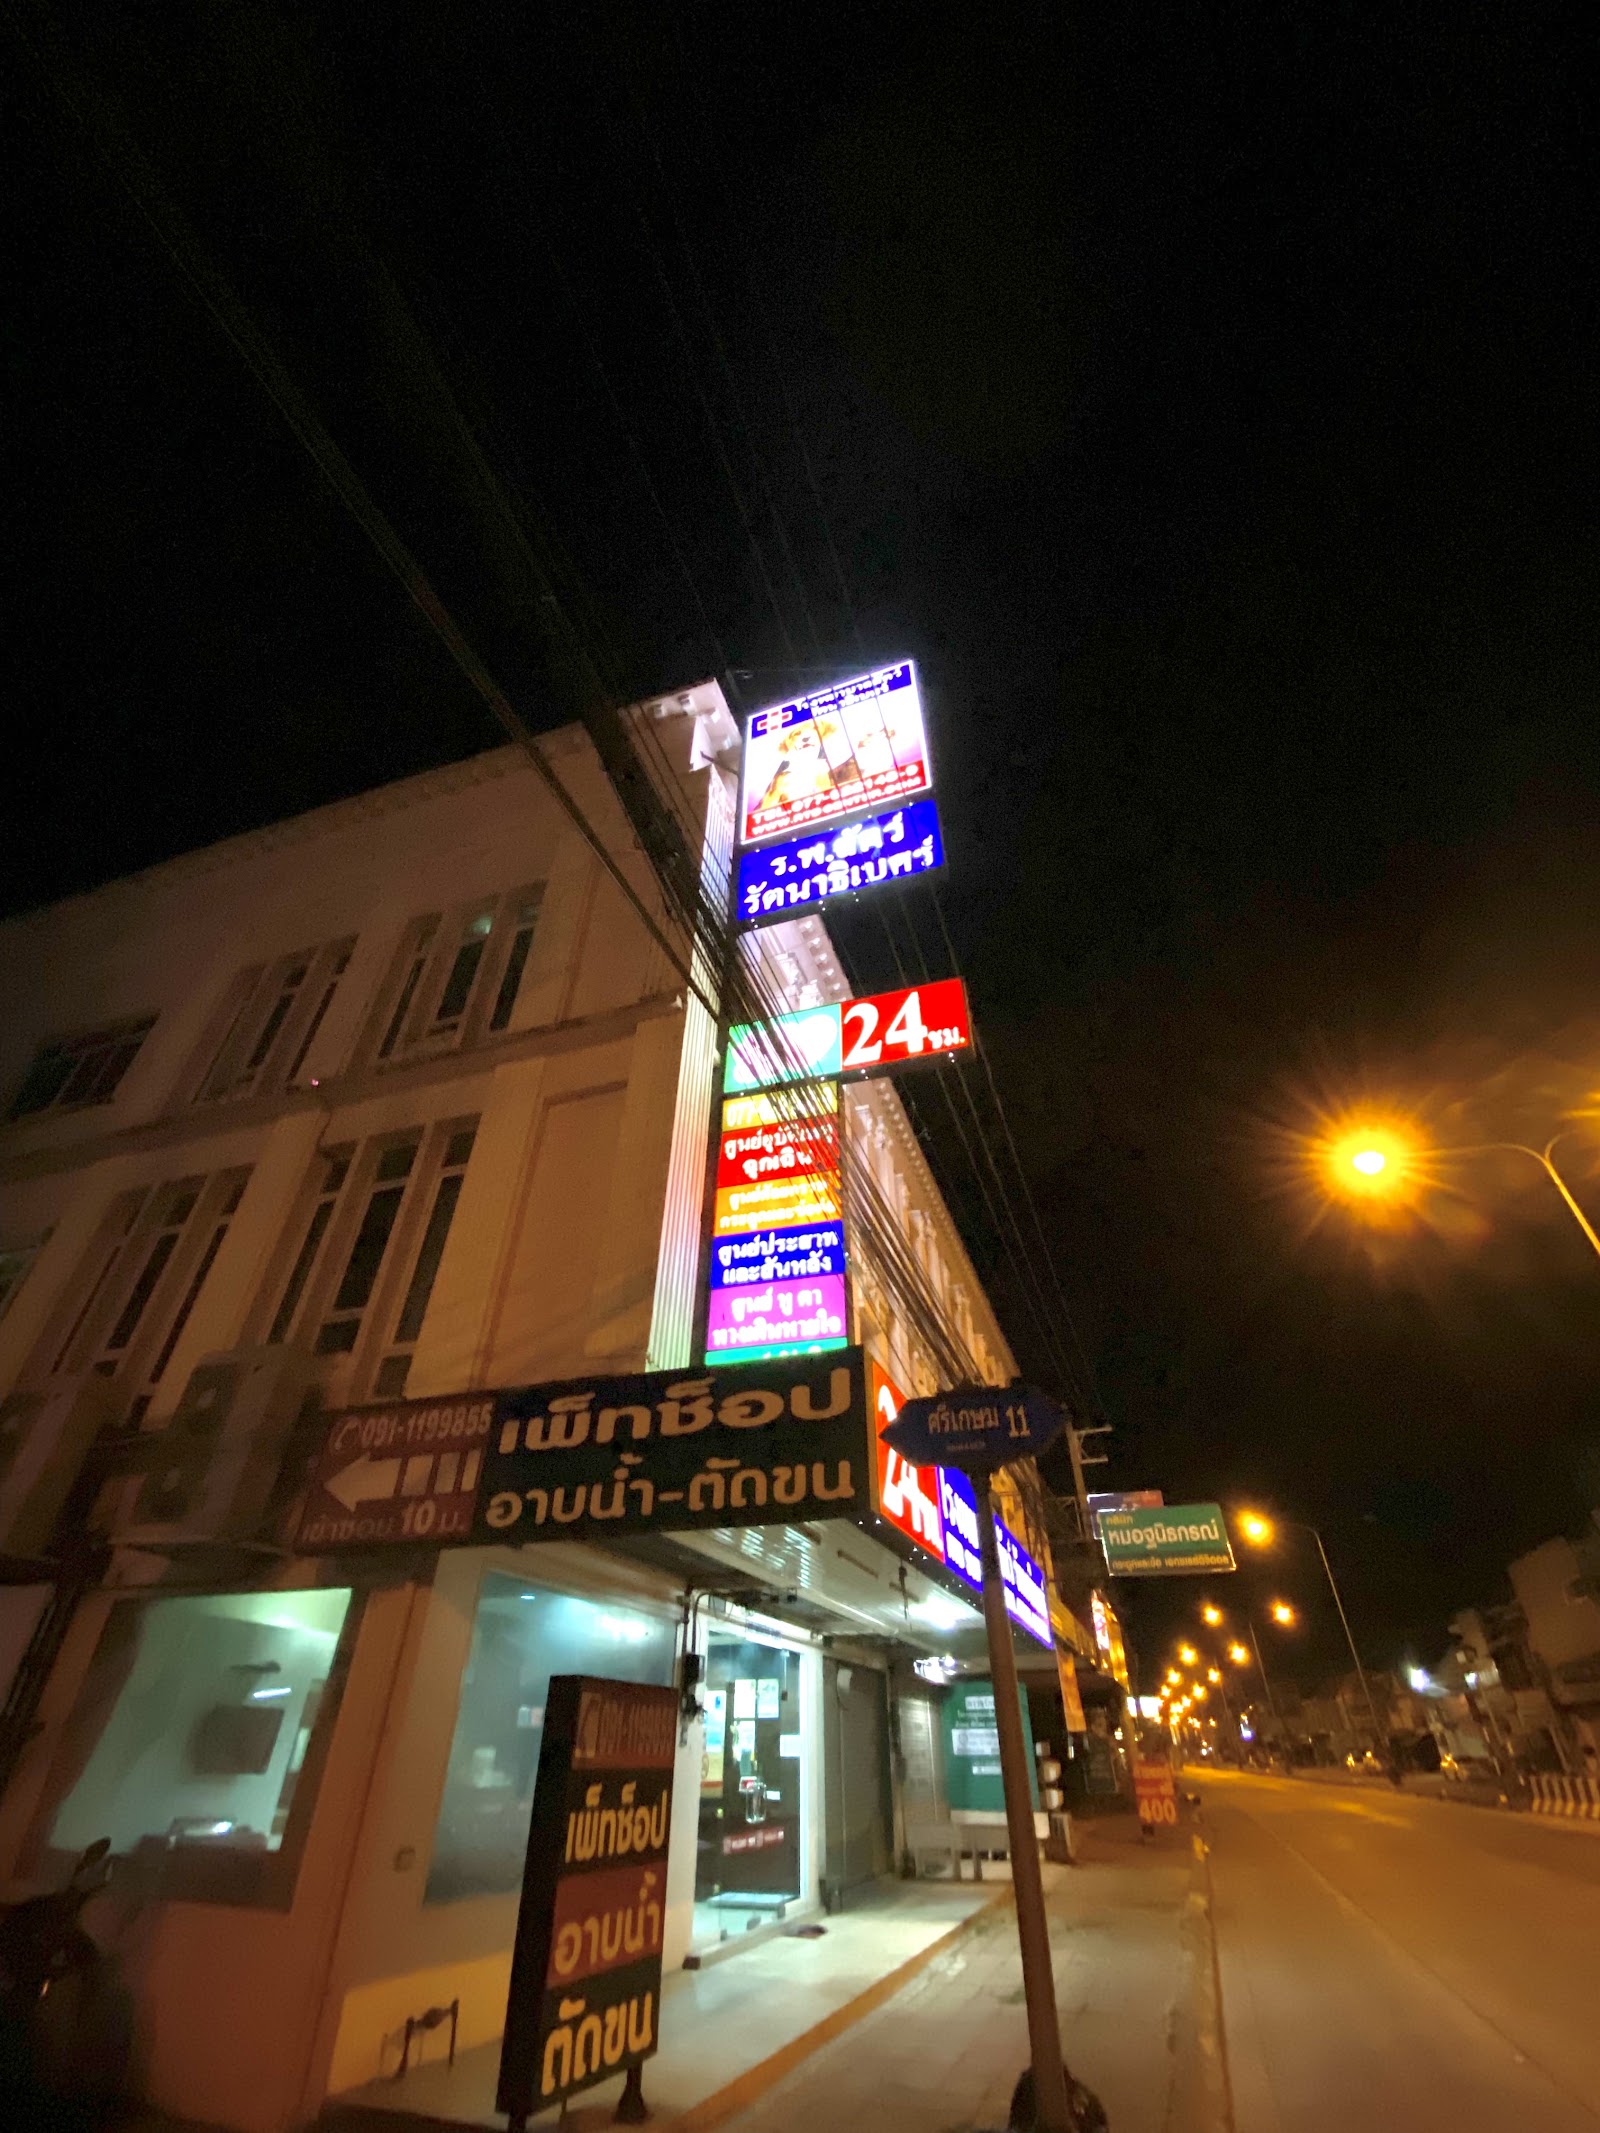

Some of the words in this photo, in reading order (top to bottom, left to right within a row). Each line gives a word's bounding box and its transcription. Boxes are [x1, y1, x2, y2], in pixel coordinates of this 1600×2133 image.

[499, 1367, 852, 1455] เพ็ทช็อป
[1005, 1404, 1032, 1438] 11
[402, 1500, 436, 1534] 10
[486, 1453, 856, 1529] อาบน้ำ-ตัดขน
[565, 1781, 668, 1865] เพ็ทช็อป
[554, 1871, 661, 1976] อาบน้ำ
[541, 1991, 653, 2097] ตัดขน
